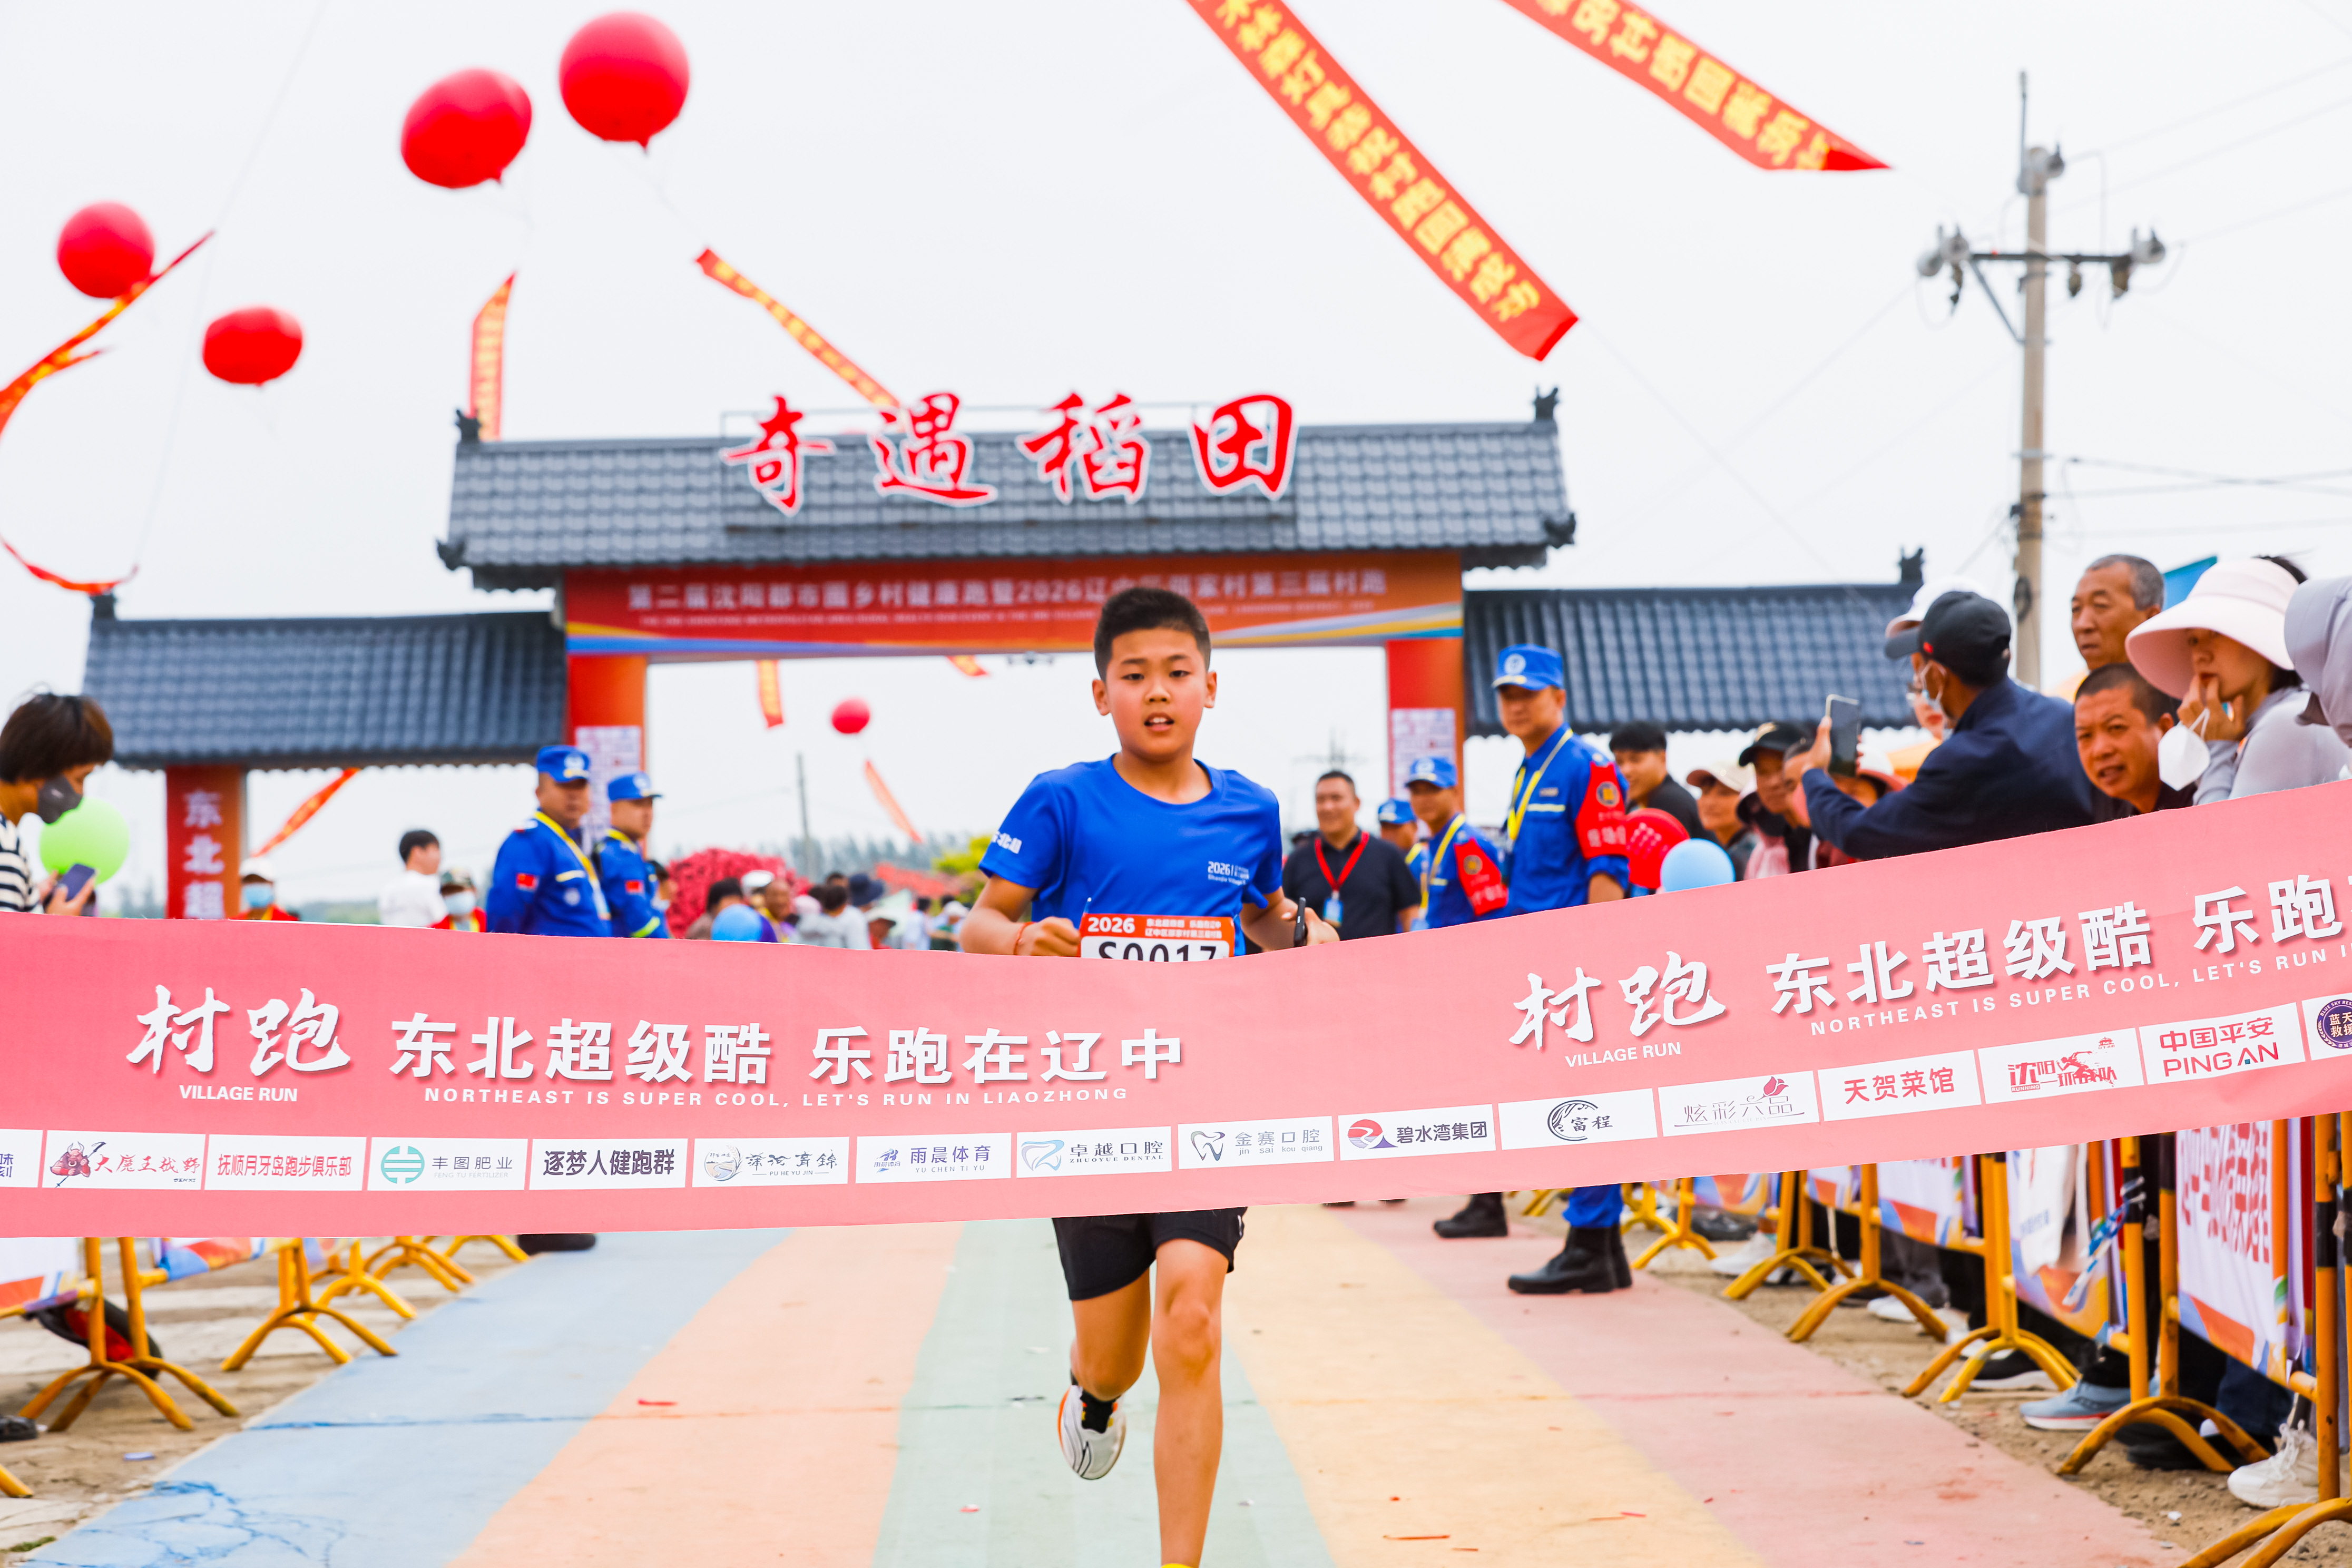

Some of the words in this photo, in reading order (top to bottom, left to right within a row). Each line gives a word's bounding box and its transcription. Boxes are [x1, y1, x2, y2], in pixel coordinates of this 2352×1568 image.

[722, 391, 1297, 515] 奇遇稻田
[1208, 861, 1231, 876] 2026
[1087, 917, 1135, 933] 2026
[1766, 901, 2152, 1015] 东北超级酷
[2192, 875, 2352, 954] 乐跑
[1811, 1001, 1959, 1036] NORTHEAST
[1972, 996, 1996, 1012] IS
[2009, 983, 2091, 1008] SUPER
[2103, 973, 2180, 996] COOL,
[2193, 960, 2261, 982] LET'S
[2276, 949, 2326, 969] RUN
[2341, 943, 2352, 957] I
[1509, 951, 1726, 1050] 村跑
[2320, 1005, 2331, 1016] BLUE
[2328, 1011, 2352, 1026] 蓝天
[126, 985, 350, 1075] 村跑
[2159, 1017, 2274, 1052] 中国平安
[2330, 1024, 2352, 1037] 救援
[389, 1012, 771, 1084] 东北超级酷
[808, 1026, 1182, 1084] 乐跑在辽中
[1565, 1047, 1637, 1067] VILLAGE
[1643, 1042, 1680, 1058] RUN
[2163, 1052, 2232, 1077] PING
[180, 1085, 253, 1100] VILLAGE
[259, 1088, 297, 1101] RUN
[1844, 1066, 1956, 1104] 天贺菜馆
[2011, 1084, 2041, 1093] RUNNING
[425, 1087, 574, 1104] NORTHEAST
[588, 1092, 608, 1104] IS
[623, 1092, 700, 1105] SUPER
[716, 1093, 788, 1107] COOL,
[803, 1094, 868, 1105] LET'S
[884, 1094, 930, 1105] RUN
[947, 1093, 968, 1104] IN
[984, 1089, 1126, 1103] LIAOZHONG
[1684, 1095, 1792, 1123] 炫彩六品
[1396, 1121, 1487, 1144] 碧水湾集团
[1570, 1115, 1613, 1132] 富程
[1235, 1129, 1320, 1147] 金赛口腔
[911, 1145, 991, 1164] 雨晨体育
[1070, 1141, 1163, 1158] 卓越口腔
[1238, 1147, 1250, 1155] jin
[1301, 1143, 1323, 1152] qiang
[218, 1154, 351, 1177] 抚顺月牙岛跑步俱乐部
[432, 1157, 512, 1170] 丰图肥业
[543, 1149, 674, 1175] 逐梦人健跑群
